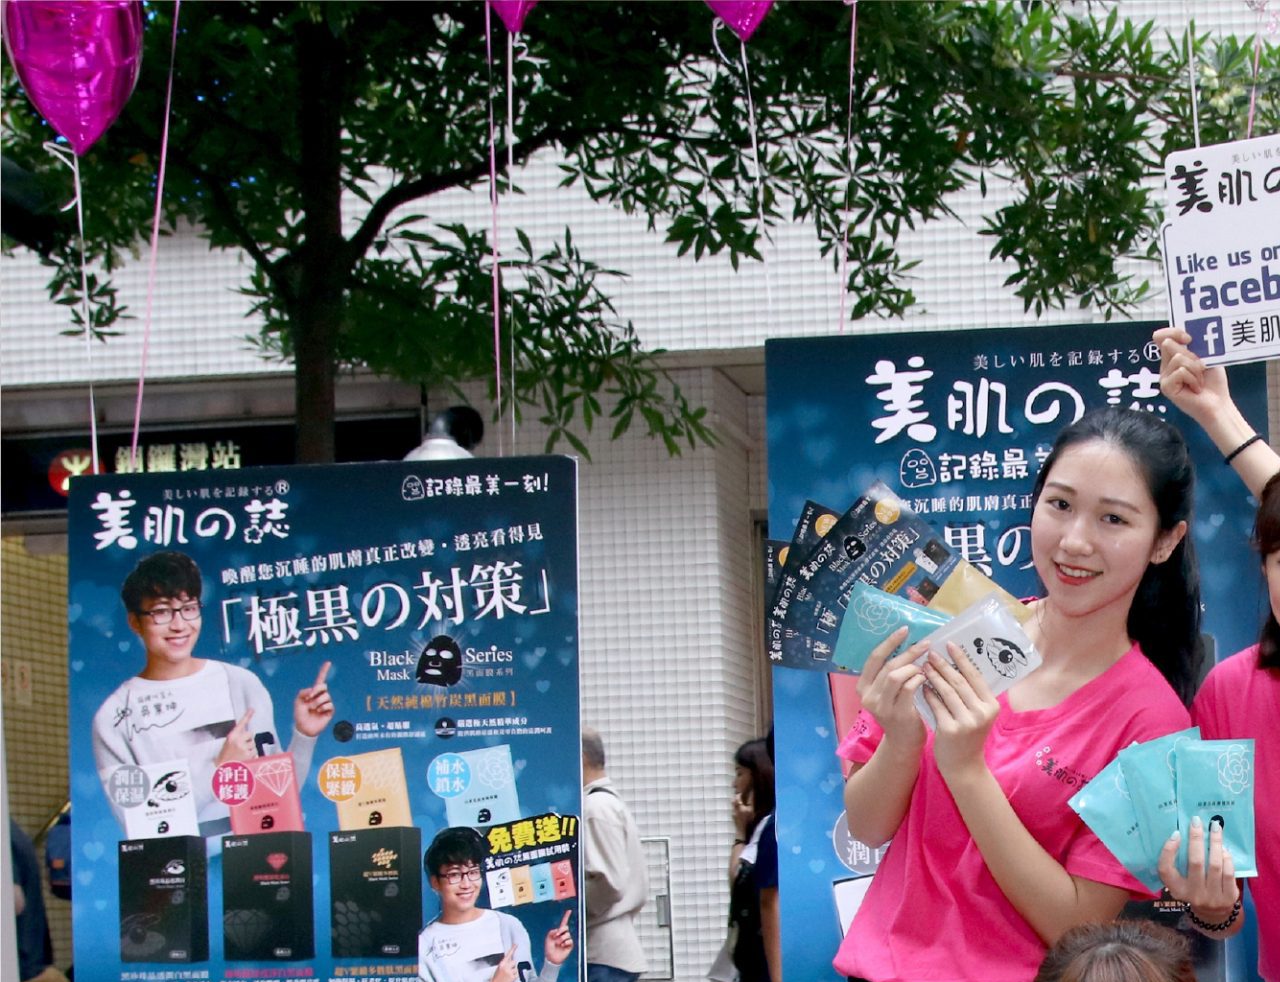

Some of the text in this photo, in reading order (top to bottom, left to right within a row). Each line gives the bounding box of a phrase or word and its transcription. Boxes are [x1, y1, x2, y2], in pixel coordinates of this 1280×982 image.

[1176, 251, 1218, 276] Like
[1228, 247, 1252, 266] us
[90, 490, 290, 550] 美肌の誌
[370, 645, 513, 667] Black Series
[377, 669, 410, 681] Mask
[487, 817, 576, 854] 免費送!!
